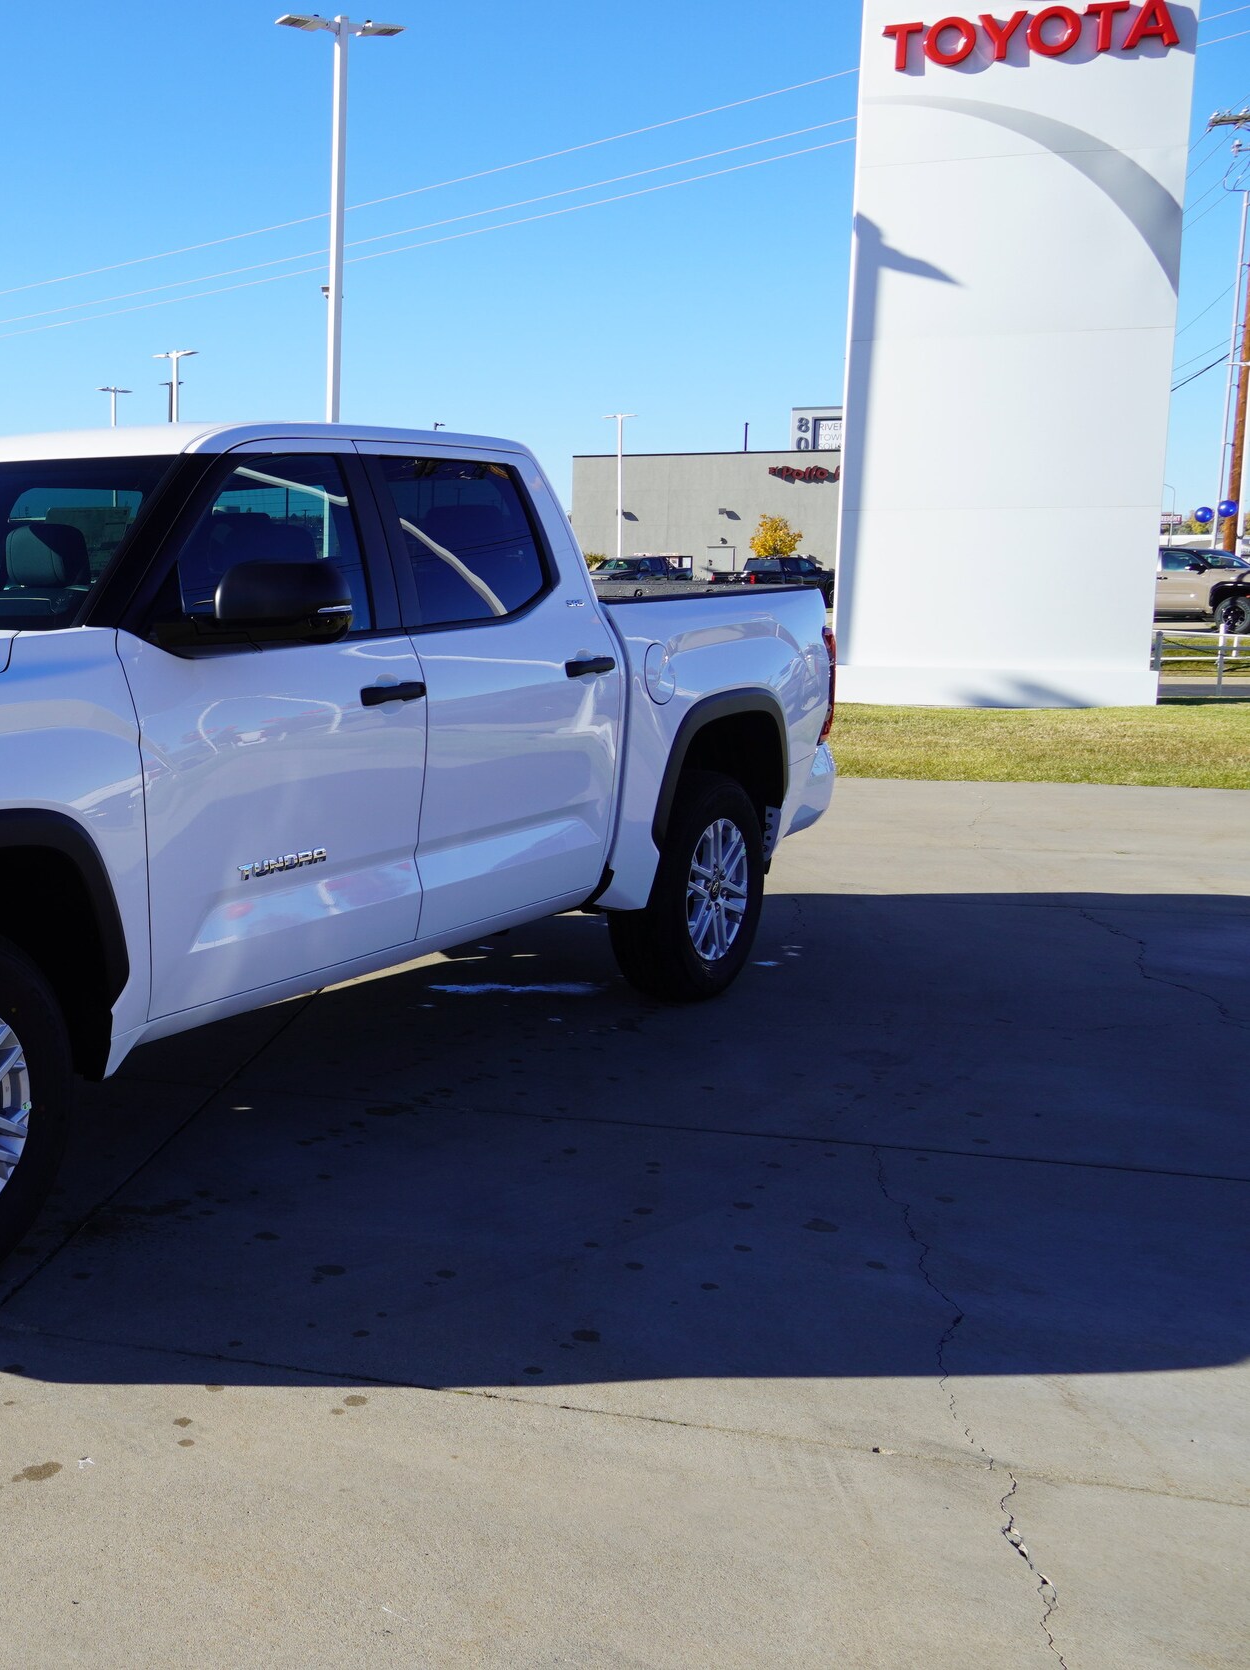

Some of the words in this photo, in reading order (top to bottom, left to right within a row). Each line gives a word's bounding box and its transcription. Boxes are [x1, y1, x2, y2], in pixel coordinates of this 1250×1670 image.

[882, 0, 1180, 72] TOYOTA
[781, 465, 829, 480] Pollo
[237, 847, 327, 881] TUNDRA
